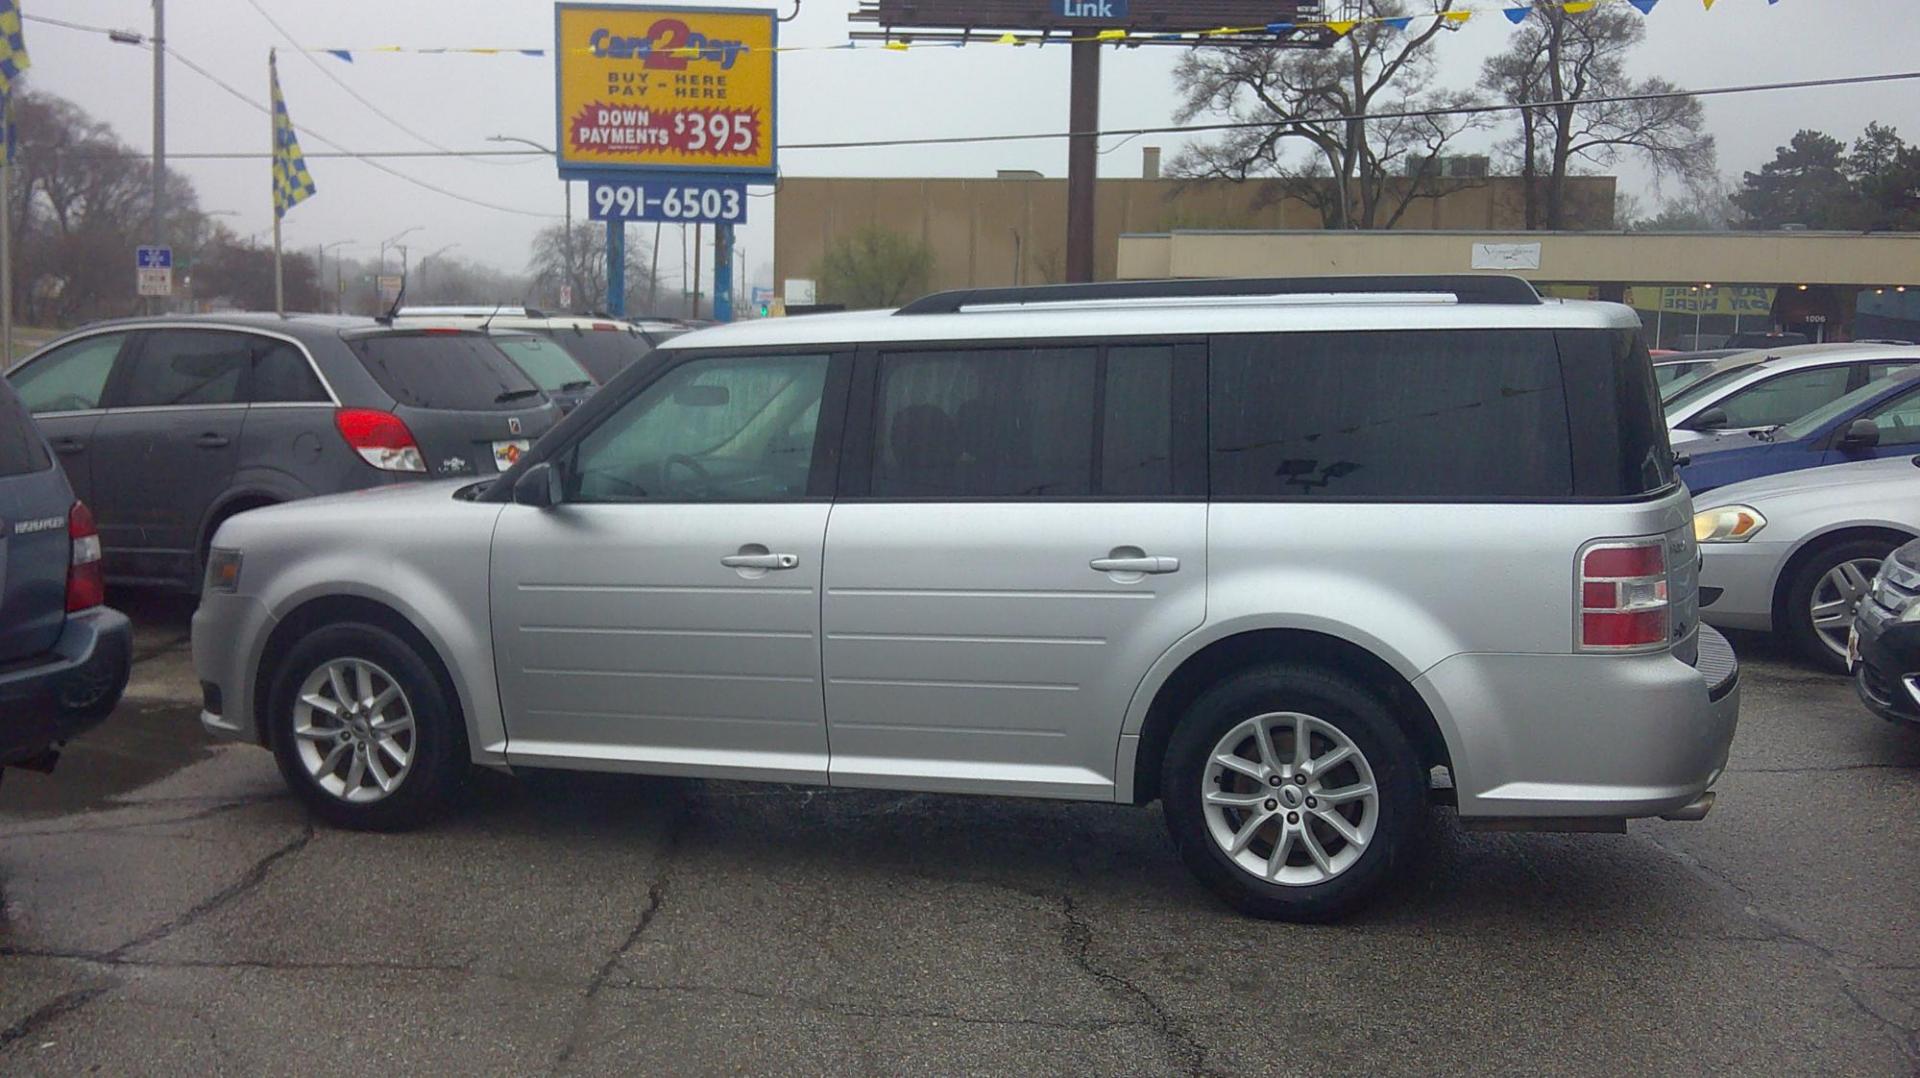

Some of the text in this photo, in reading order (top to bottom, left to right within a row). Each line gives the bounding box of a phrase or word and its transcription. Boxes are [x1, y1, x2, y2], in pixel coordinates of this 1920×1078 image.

[1064, 0, 1112, 17] Link
[608, 72, 727, 86] BUY HERE
[608, 85, 727, 99] PAY HERE
[598, 110, 649, 126] DOWN
[579, 127, 669, 145] PAYMENTS
[674, 112, 752, 151] $395
[595, 186, 740, 219] 991-6503
